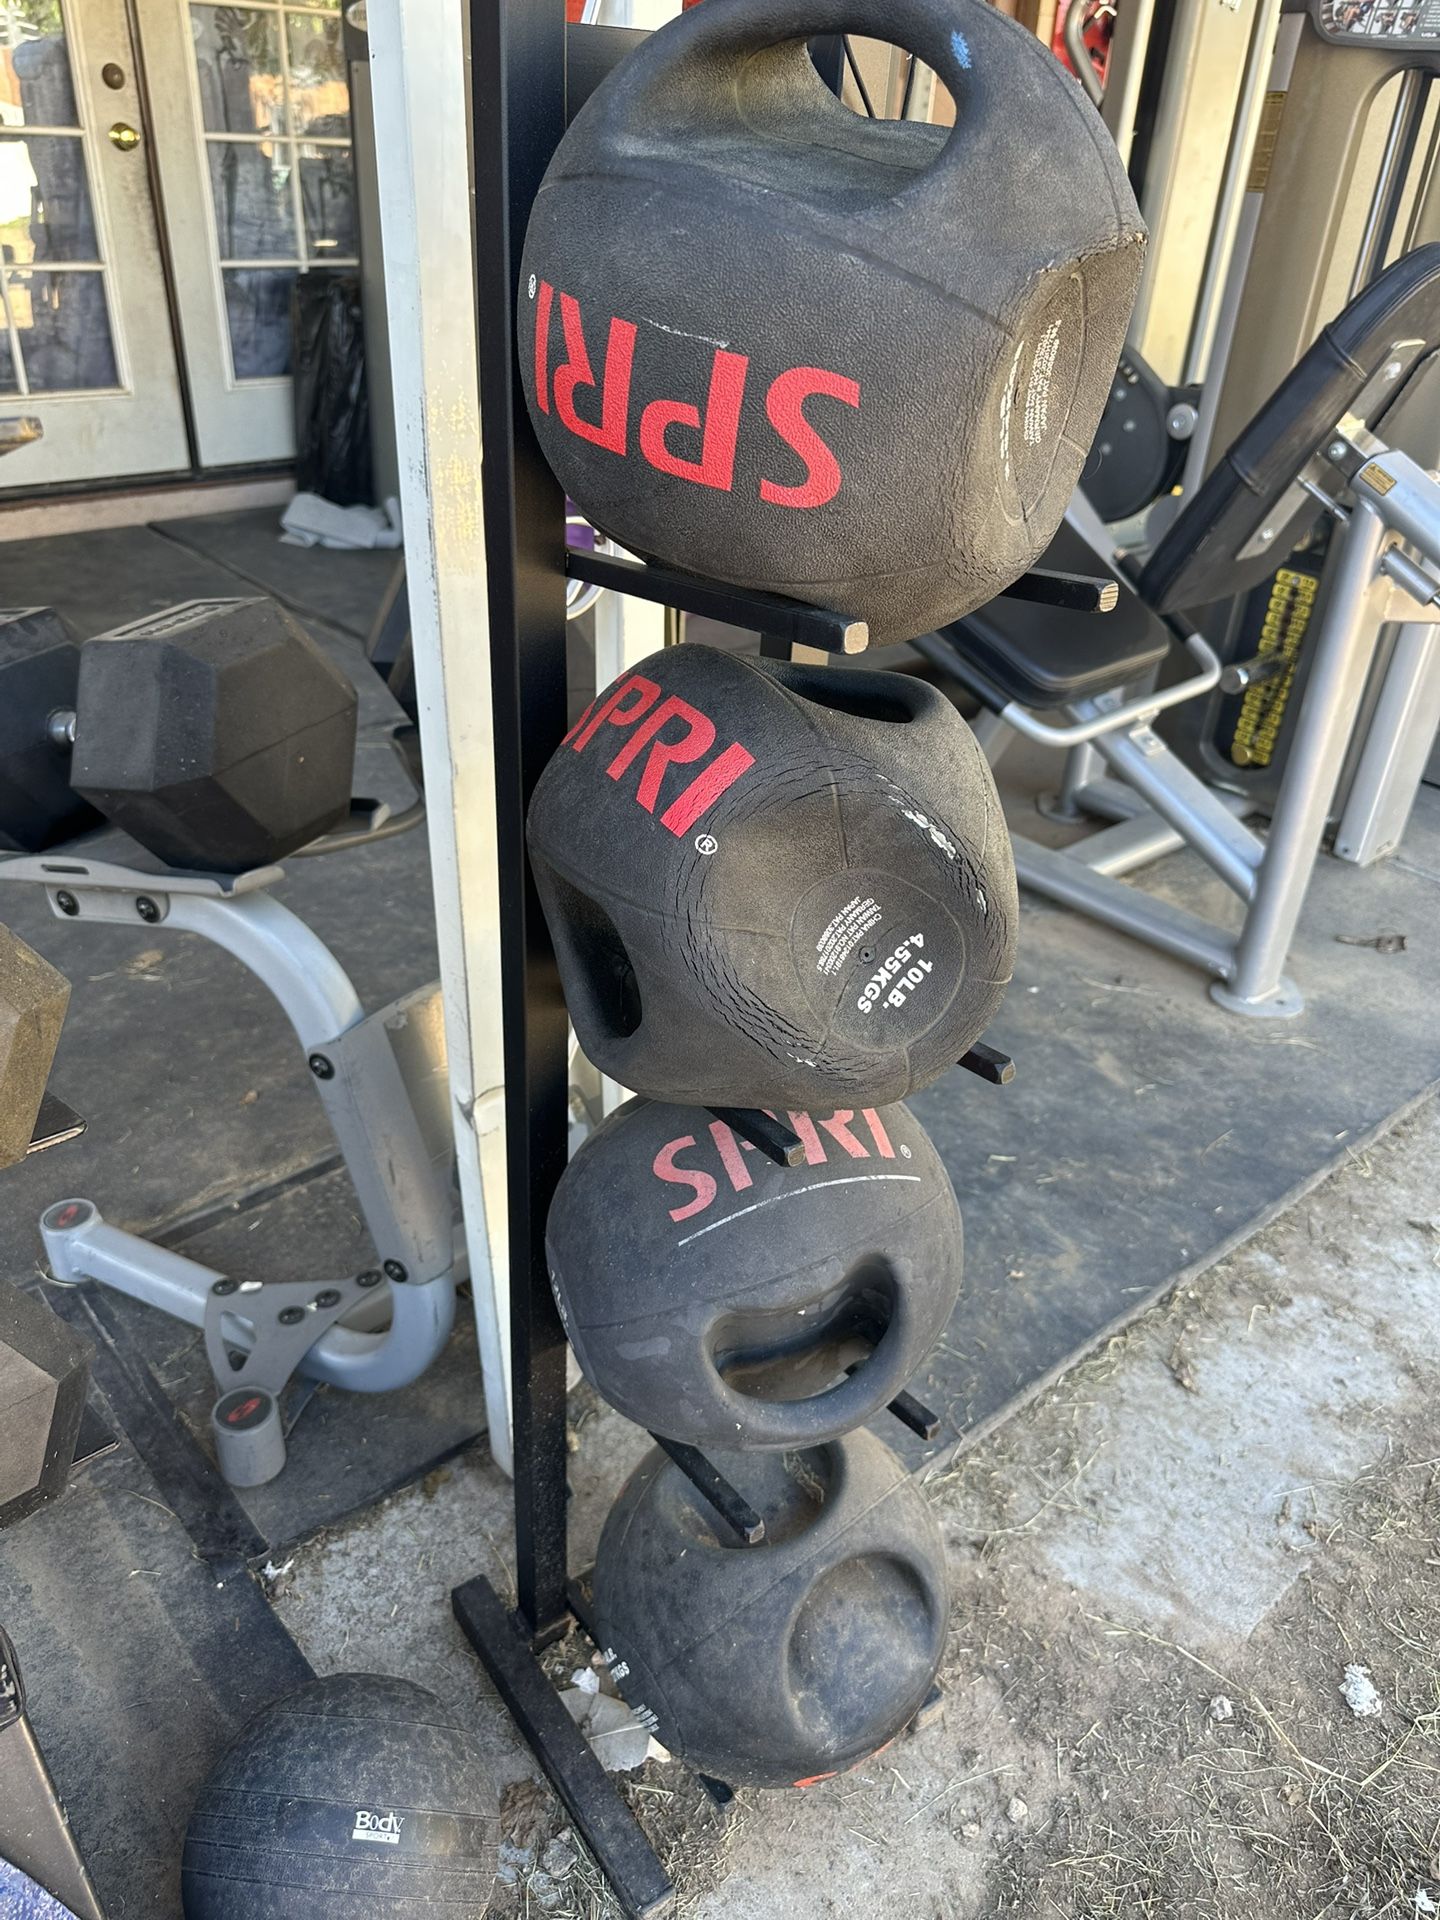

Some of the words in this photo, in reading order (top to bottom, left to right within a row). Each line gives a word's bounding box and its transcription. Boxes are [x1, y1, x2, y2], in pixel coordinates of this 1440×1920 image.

[534, 279, 860, 508] SPRI
[839, 896, 861, 917] JAPAN
[842, 897, 875, 927] GERMANY
[856, 904, 882, 926] TAIWAN
[845, 921, 859, 938] PAT
[858, 913, 883, 934] CHINA
[857, 932, 925, 1014] 4.55KGS
[882, 959, 933, 1009] 10LB.
[356, 1811, 405, 1833] Body
